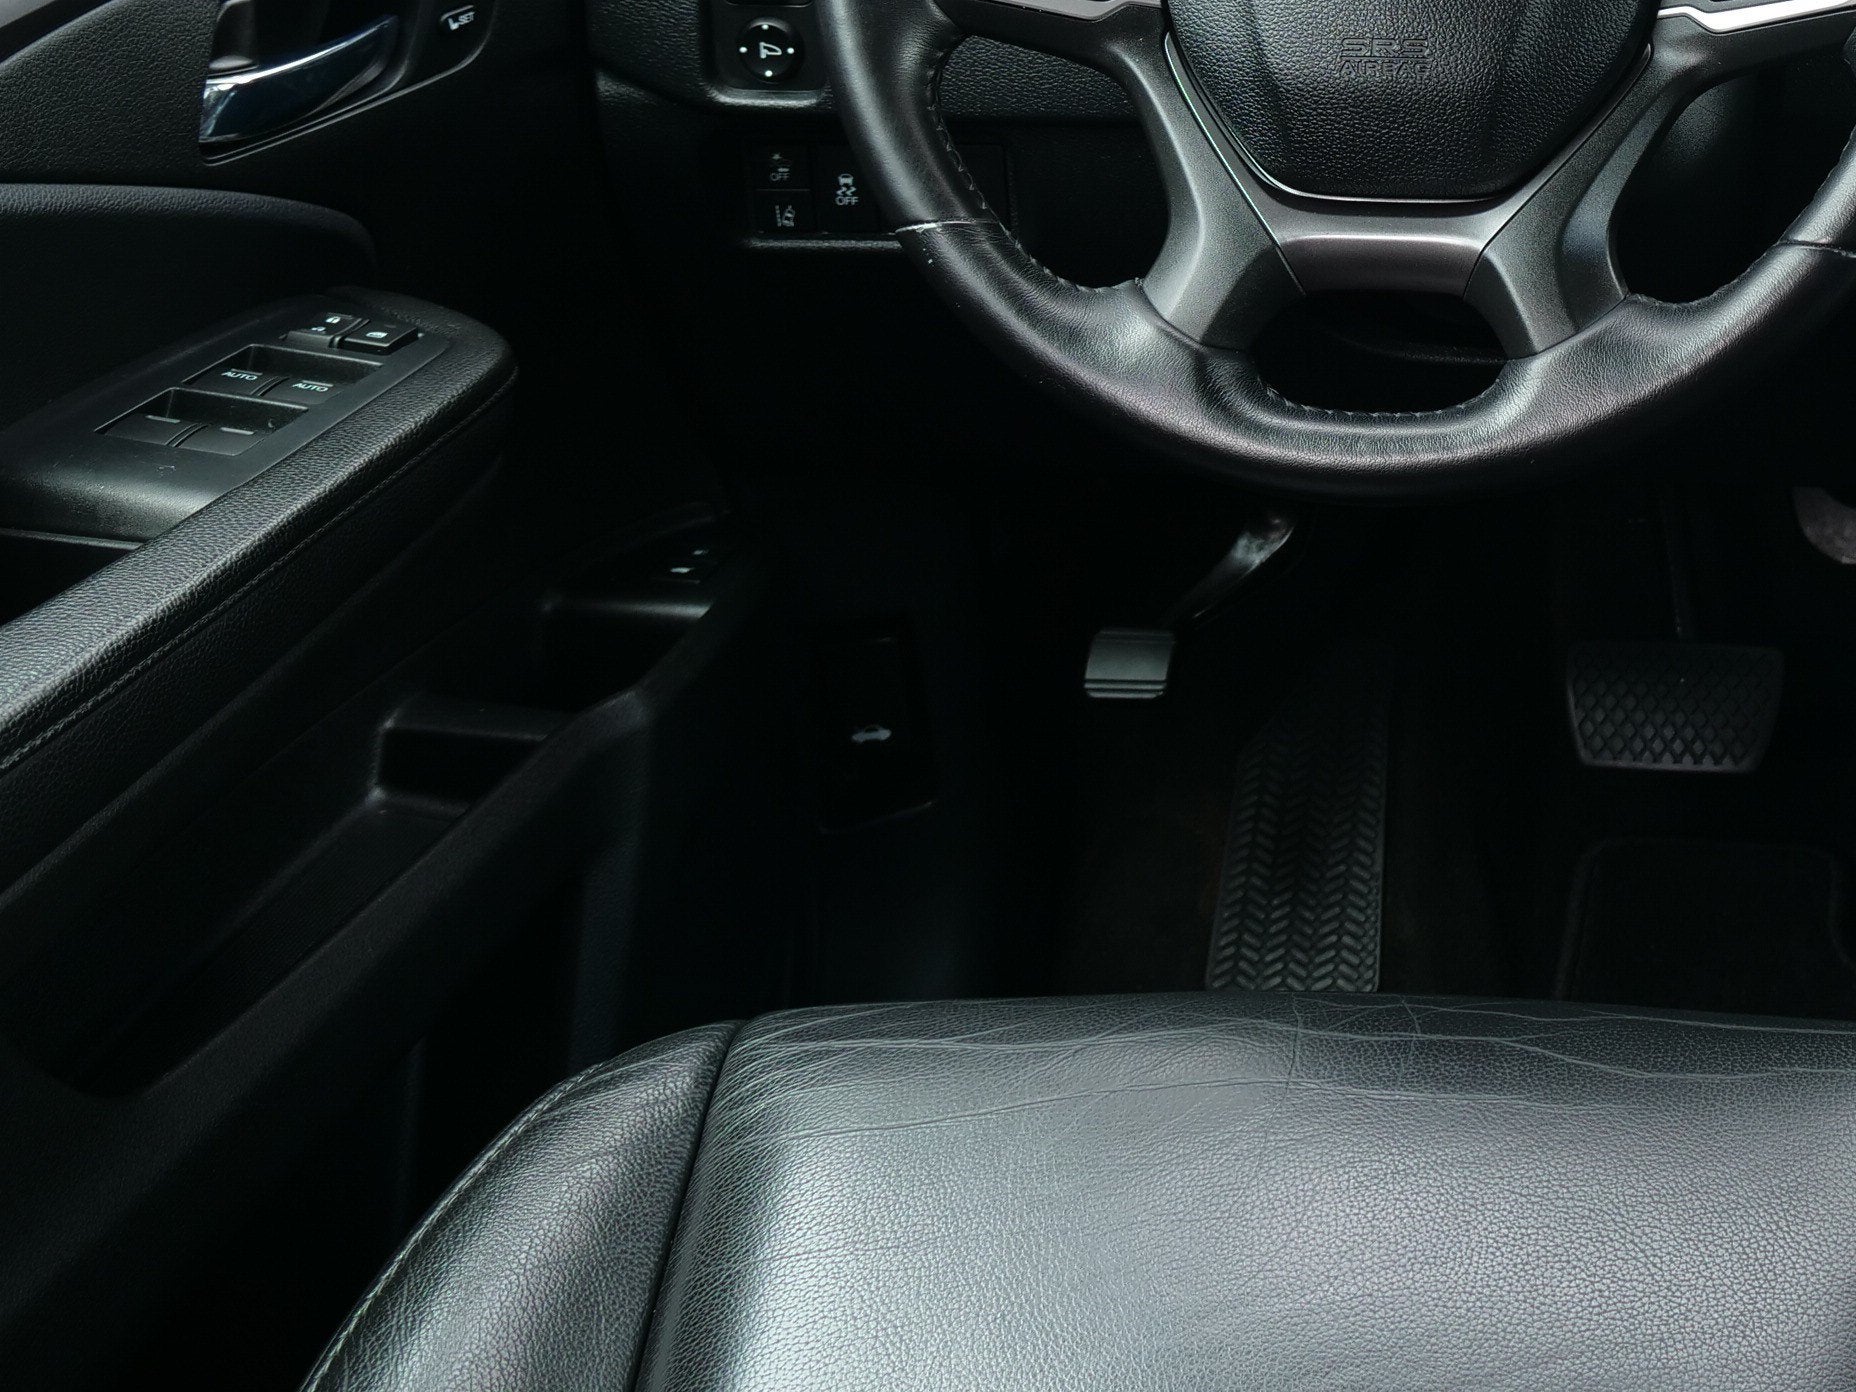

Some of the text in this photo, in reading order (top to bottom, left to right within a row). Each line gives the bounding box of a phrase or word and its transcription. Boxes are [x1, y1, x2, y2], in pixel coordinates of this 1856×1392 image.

[836, 196, 859, 206] OFF
[221, 370, 258, 381] AUTO
[292, 382, 329, 393] AUTO
